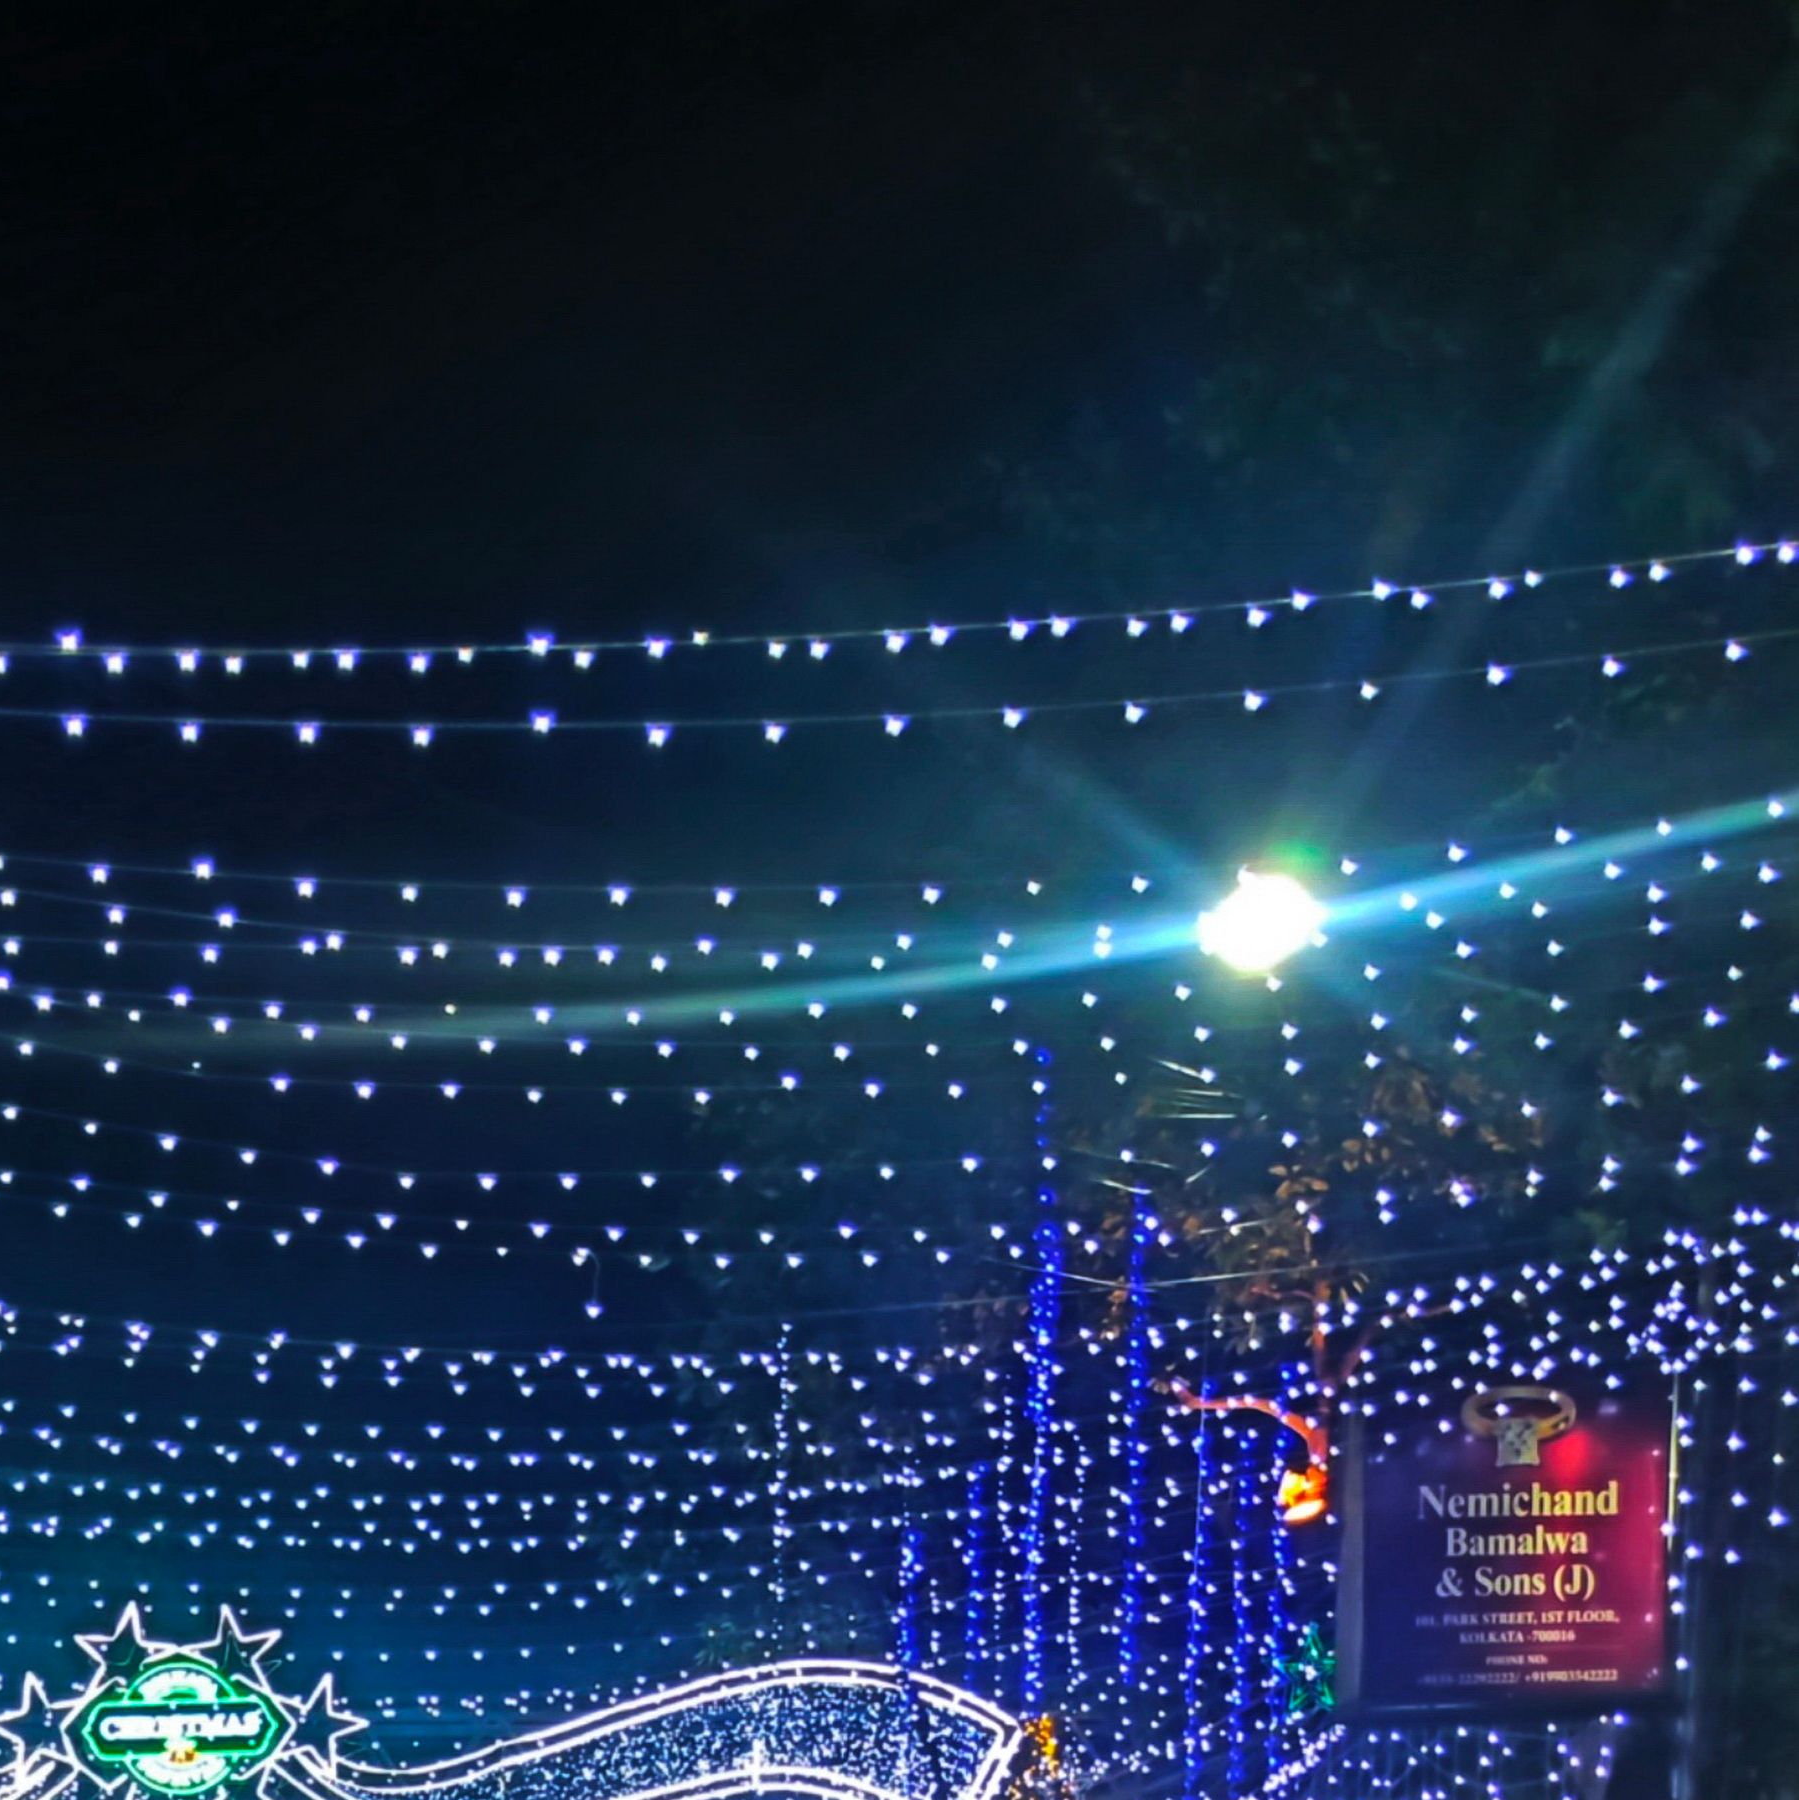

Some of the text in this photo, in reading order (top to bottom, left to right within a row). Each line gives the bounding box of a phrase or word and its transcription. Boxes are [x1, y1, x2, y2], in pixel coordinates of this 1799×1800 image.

[1417, 1480, 1619, 1520] Nemichand
[1446, 1524, 1589, 1557] Bamalwa
[1435, 1564, 1596, 1602] & Sons (J)
[1443, 1613, 1478, 1626] PARK
[1567, 1610, 1620, 1624] FLOOR,
[1459, 1630, 1524, 1644] KOLKATA
